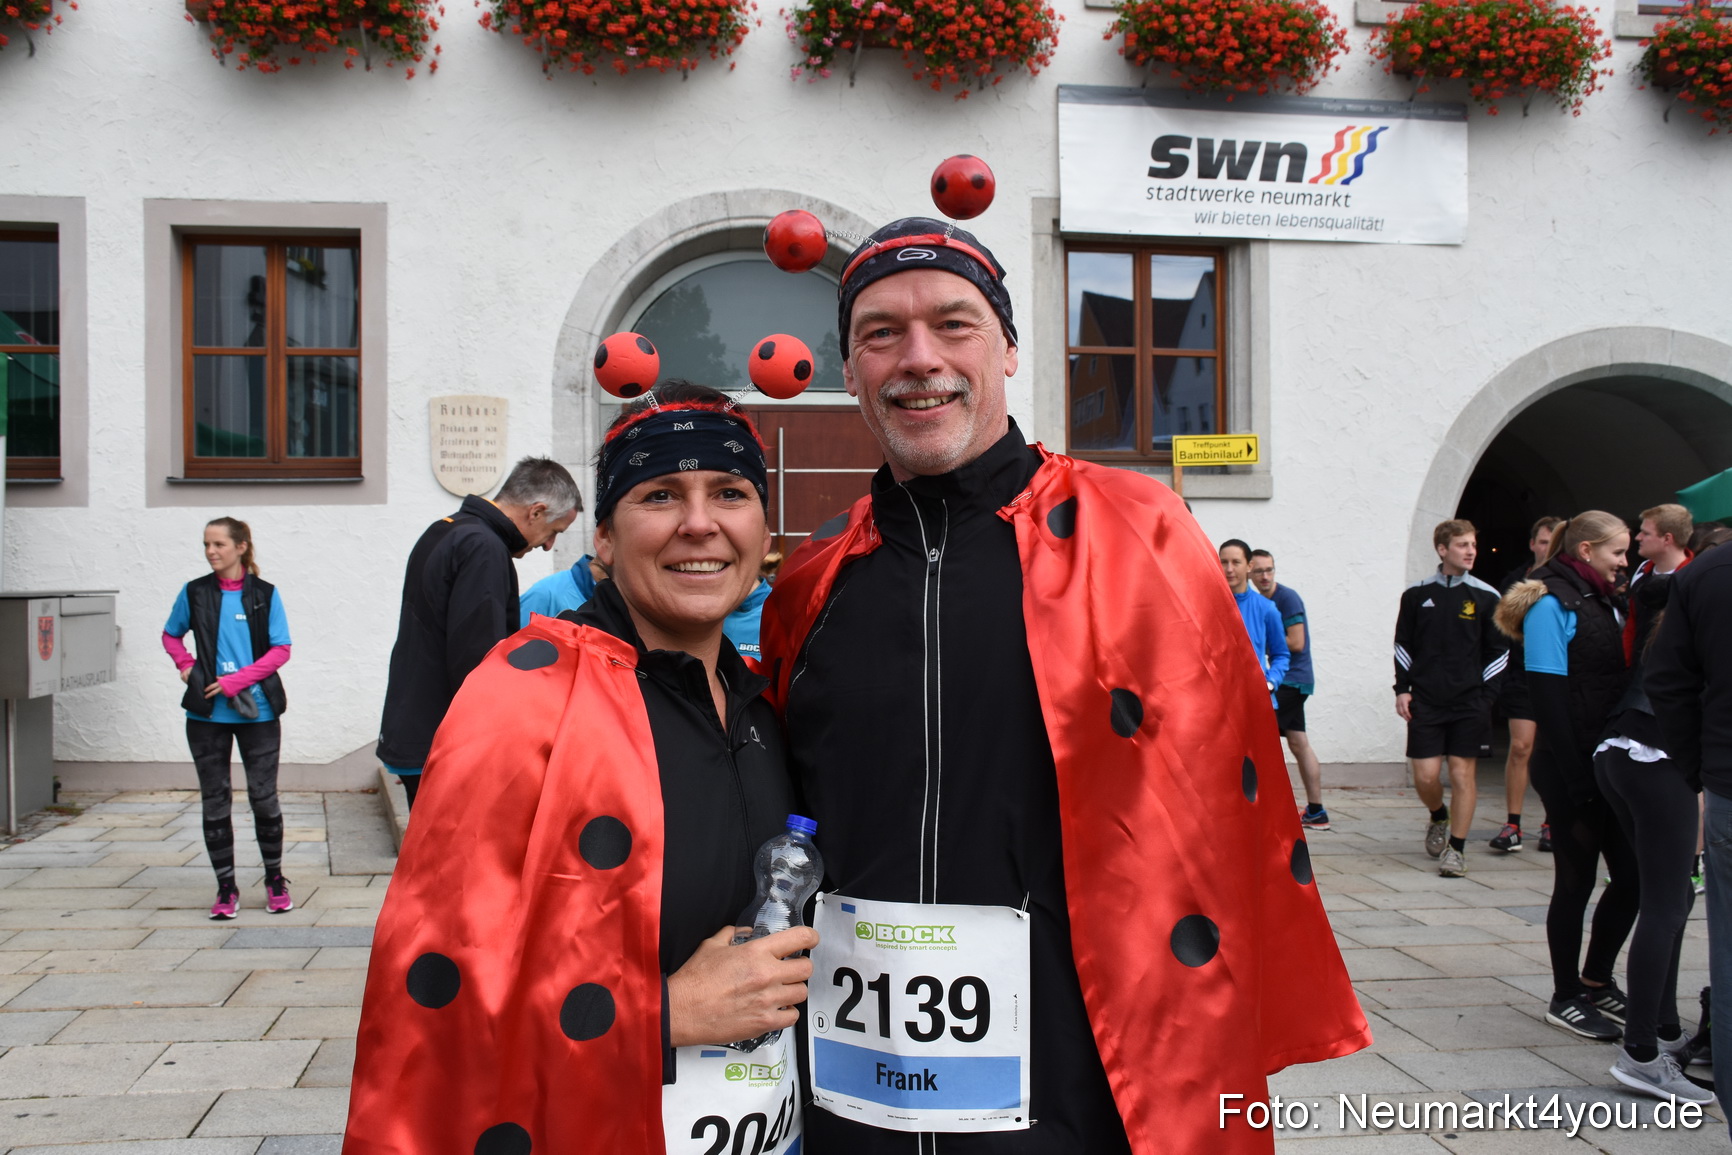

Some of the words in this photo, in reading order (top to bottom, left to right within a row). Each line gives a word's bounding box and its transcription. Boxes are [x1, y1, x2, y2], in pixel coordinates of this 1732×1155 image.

[1147, 134, 1308, 183] swn
[1146, 185, 1255, 204] stadtwerke
[1261, 189, 1352, 208] neumarkt
[1194, 211, 1217, 225] wir
[1221, 210, 1271, 227] bieten
[1276, 213, 1385, 232] lebensqualität!
[1179, 450, 1243, 460] Bambinilauf
[1193, 441, 1231, 449] Treffpunkt
[738, 643, 760, 652] BOC
[876, 923, 957, 944] BOCK
[875, 942, 899, 950] inspired
[833, 966, 991, 1043] 2139
[817, 1017, 824, 1028] D
[876, 1062, 938, 1091] Frank
[691, 1080, 795, 1155] 2041
